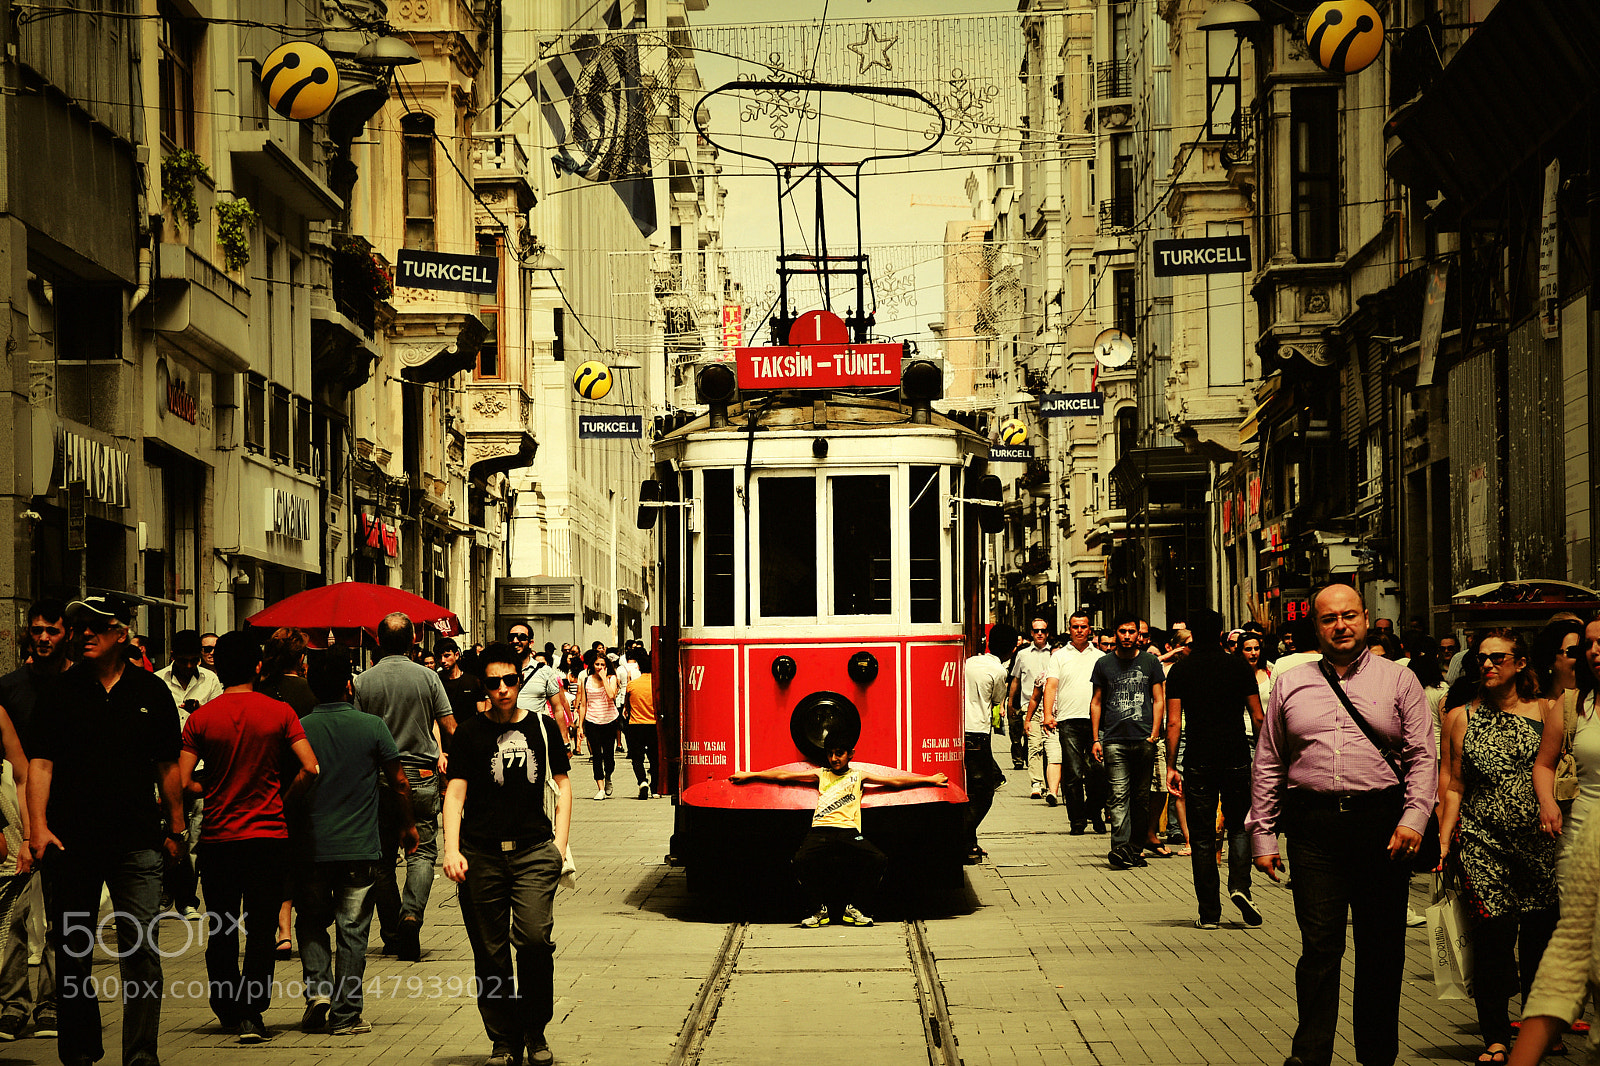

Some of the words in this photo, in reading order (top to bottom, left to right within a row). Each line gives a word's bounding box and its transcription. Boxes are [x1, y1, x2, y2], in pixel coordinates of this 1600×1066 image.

[1160, 246, 1246, 266] TURKCELL
[402, 260, 493, 284] TURKCELL
[814, 314, 821, 342] 1
[750, 351, 813, 378] TAKSİM
[833, 350, 892, 376] TÜNEL
[1043, 398, 1101, 411] URKCELL
[581, 421, 639, 433] TURKCELL
[990, 448, 1032, 459] TURKCELL
[688, 665, 705, 691] 47
[940, 661, 957, 687] 47
[503, 752, 526, 769] 77
[922, 752, 932, 762] VE
